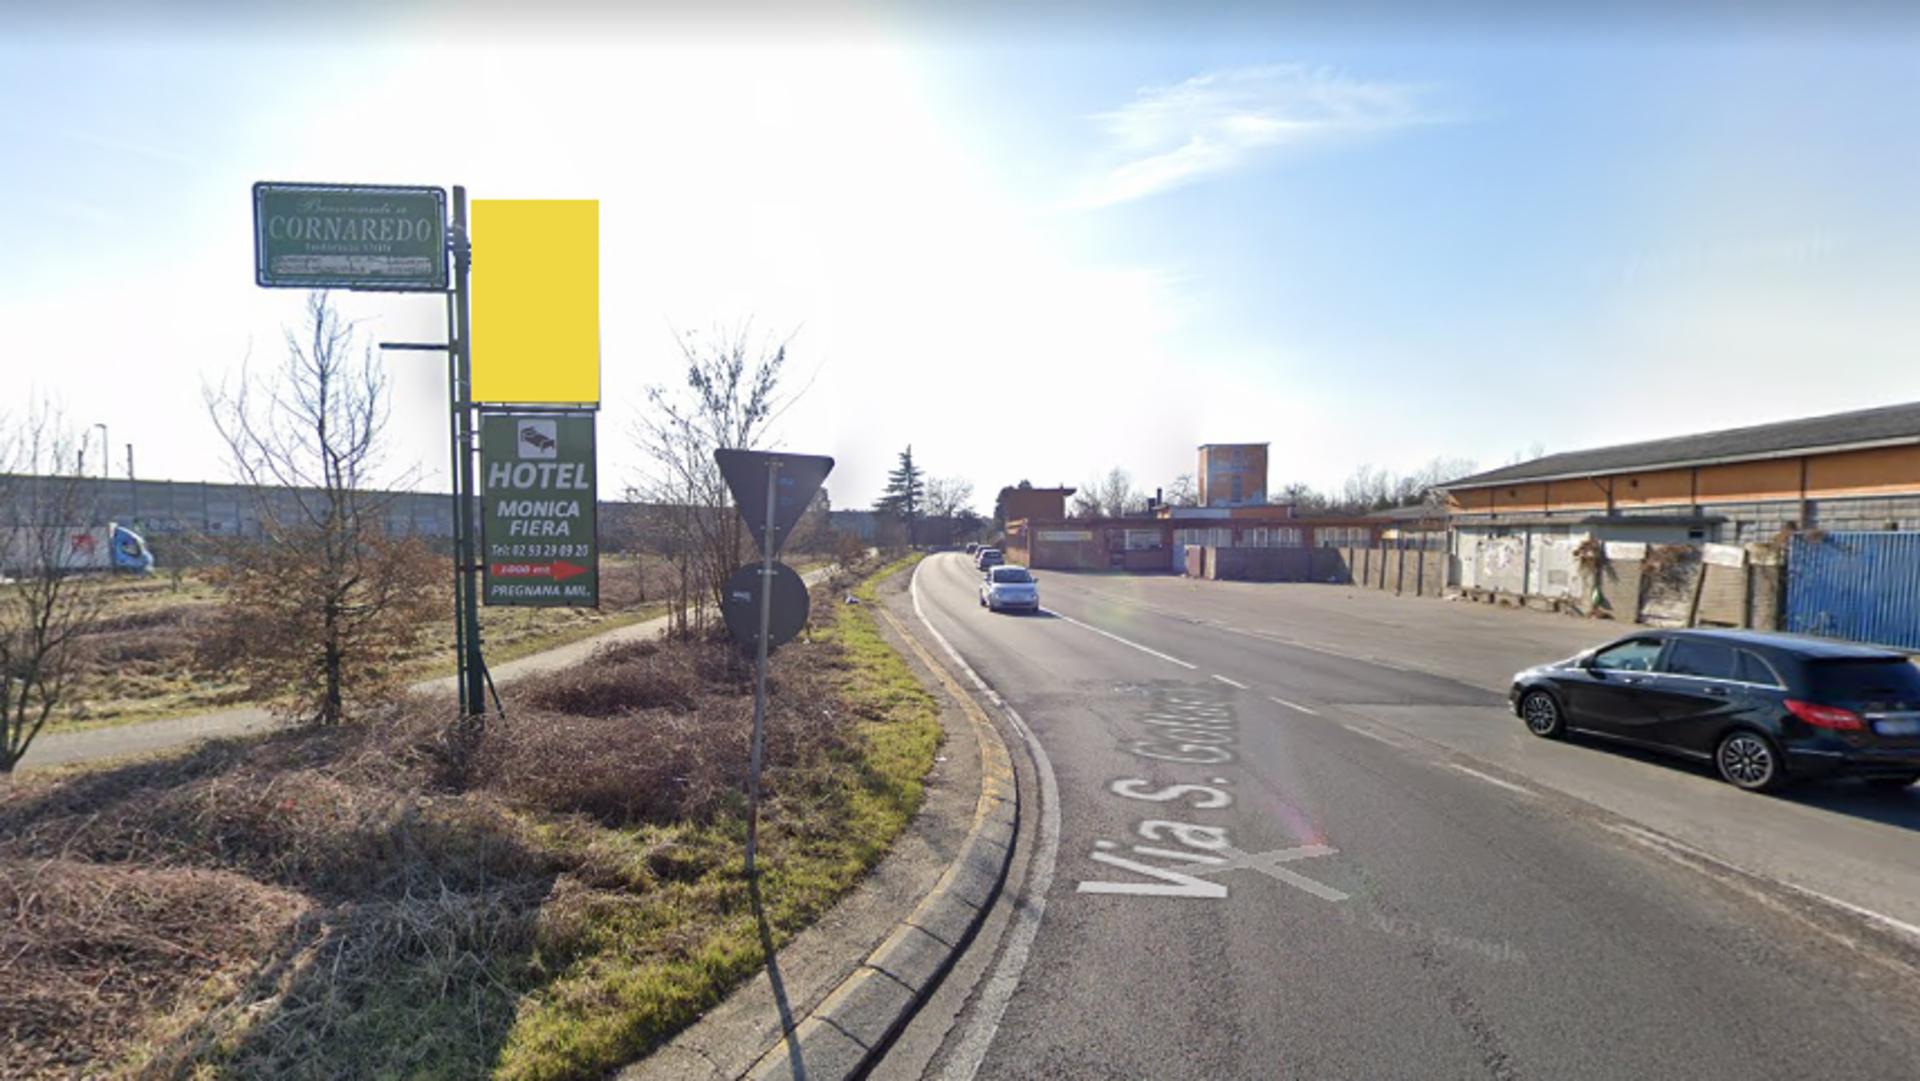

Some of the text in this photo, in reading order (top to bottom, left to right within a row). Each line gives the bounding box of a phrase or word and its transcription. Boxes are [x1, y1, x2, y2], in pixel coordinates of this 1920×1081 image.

[269, 214, 431, 241] CORNAREDO
[489, 462, 589, 490] HOTEL
[497, 500, 580, 518] MONICA
[510, 520, 570, 536] FIERA
[511, 544, 525, 557] 02
[543, 544, 557, 557] 29
[575, 544, 589, 557] 20
[491, 585, 561, 597] PREGNANA
